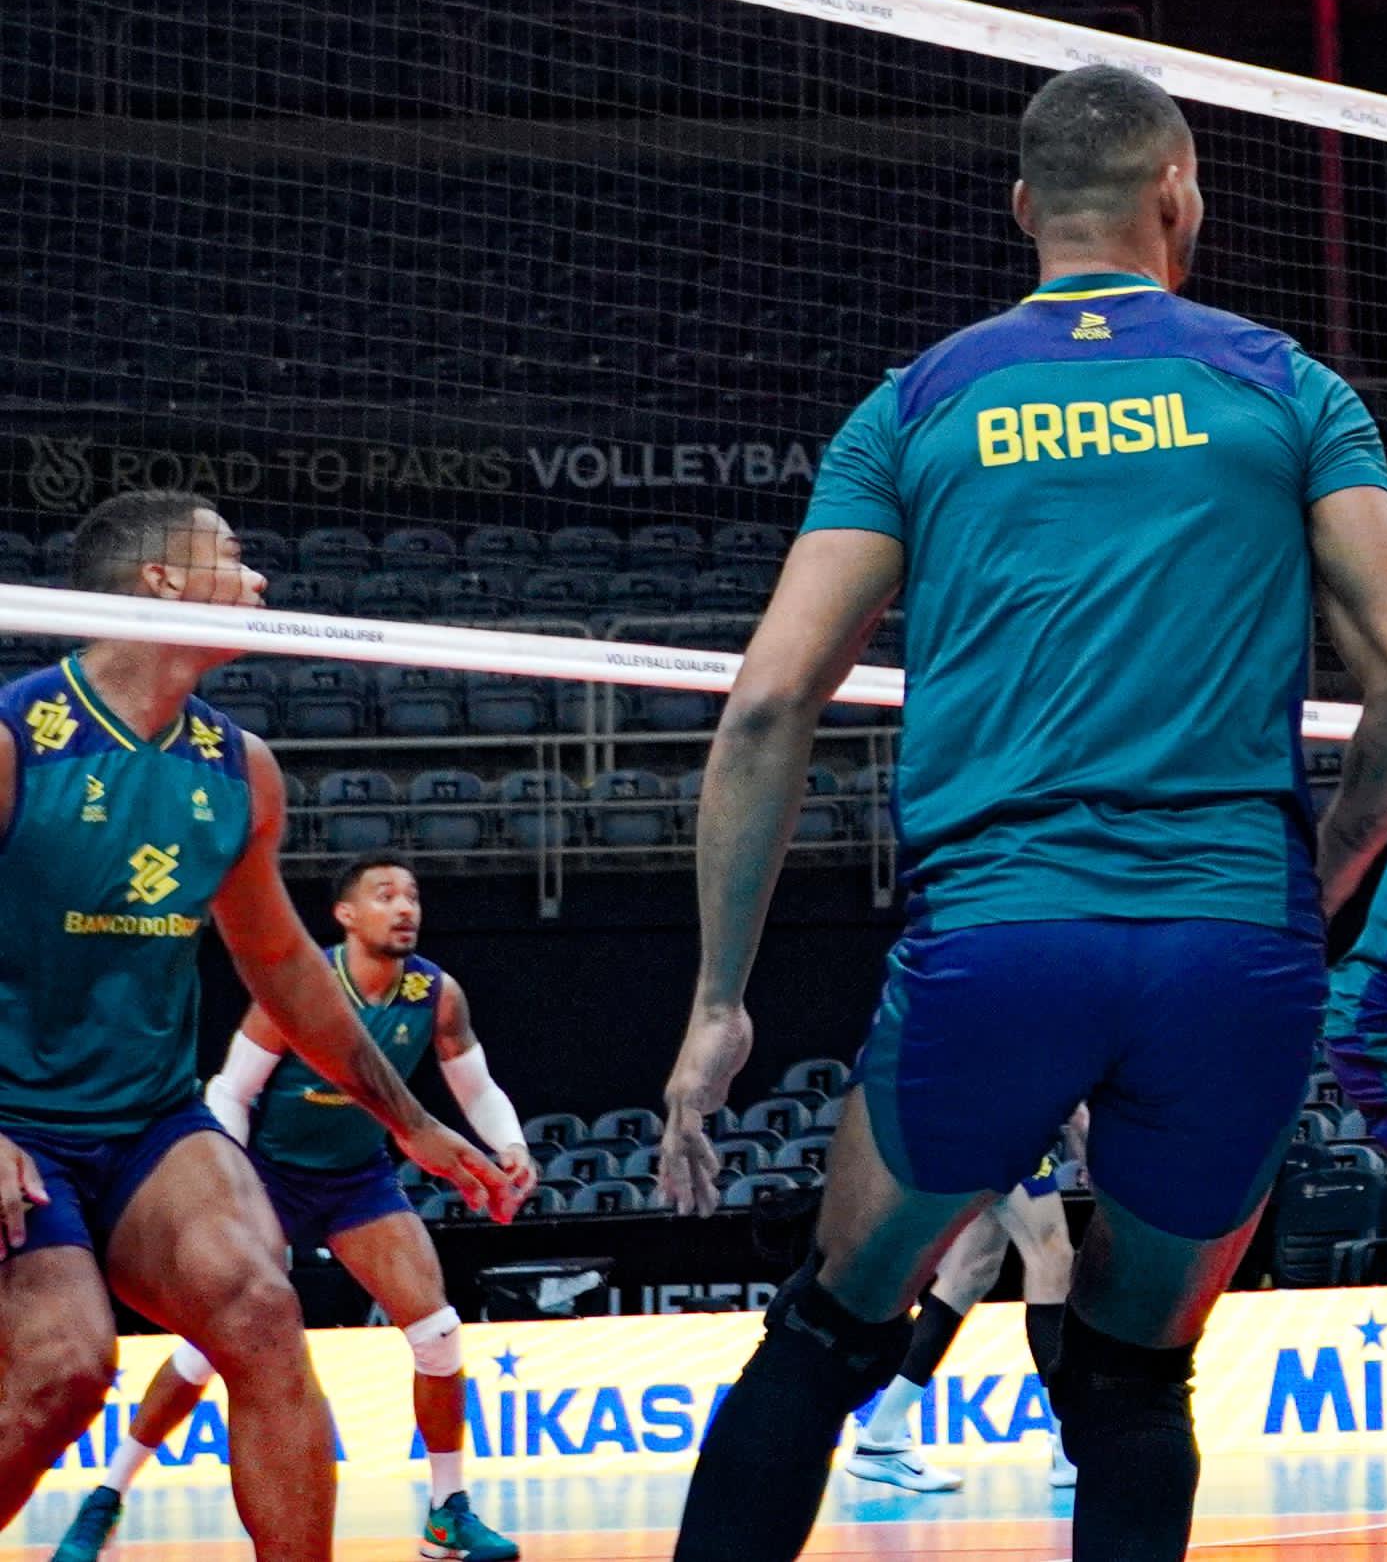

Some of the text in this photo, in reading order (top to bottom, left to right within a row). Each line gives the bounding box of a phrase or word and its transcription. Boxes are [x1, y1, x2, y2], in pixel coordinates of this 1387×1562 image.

[977, 392, 1209, 468] BRASIL
[277, 448, 347, 493] TO
[527, 442, 816, 490] VOLLEYBA
[246, 621, 320, 638] VOLLEYBALL
